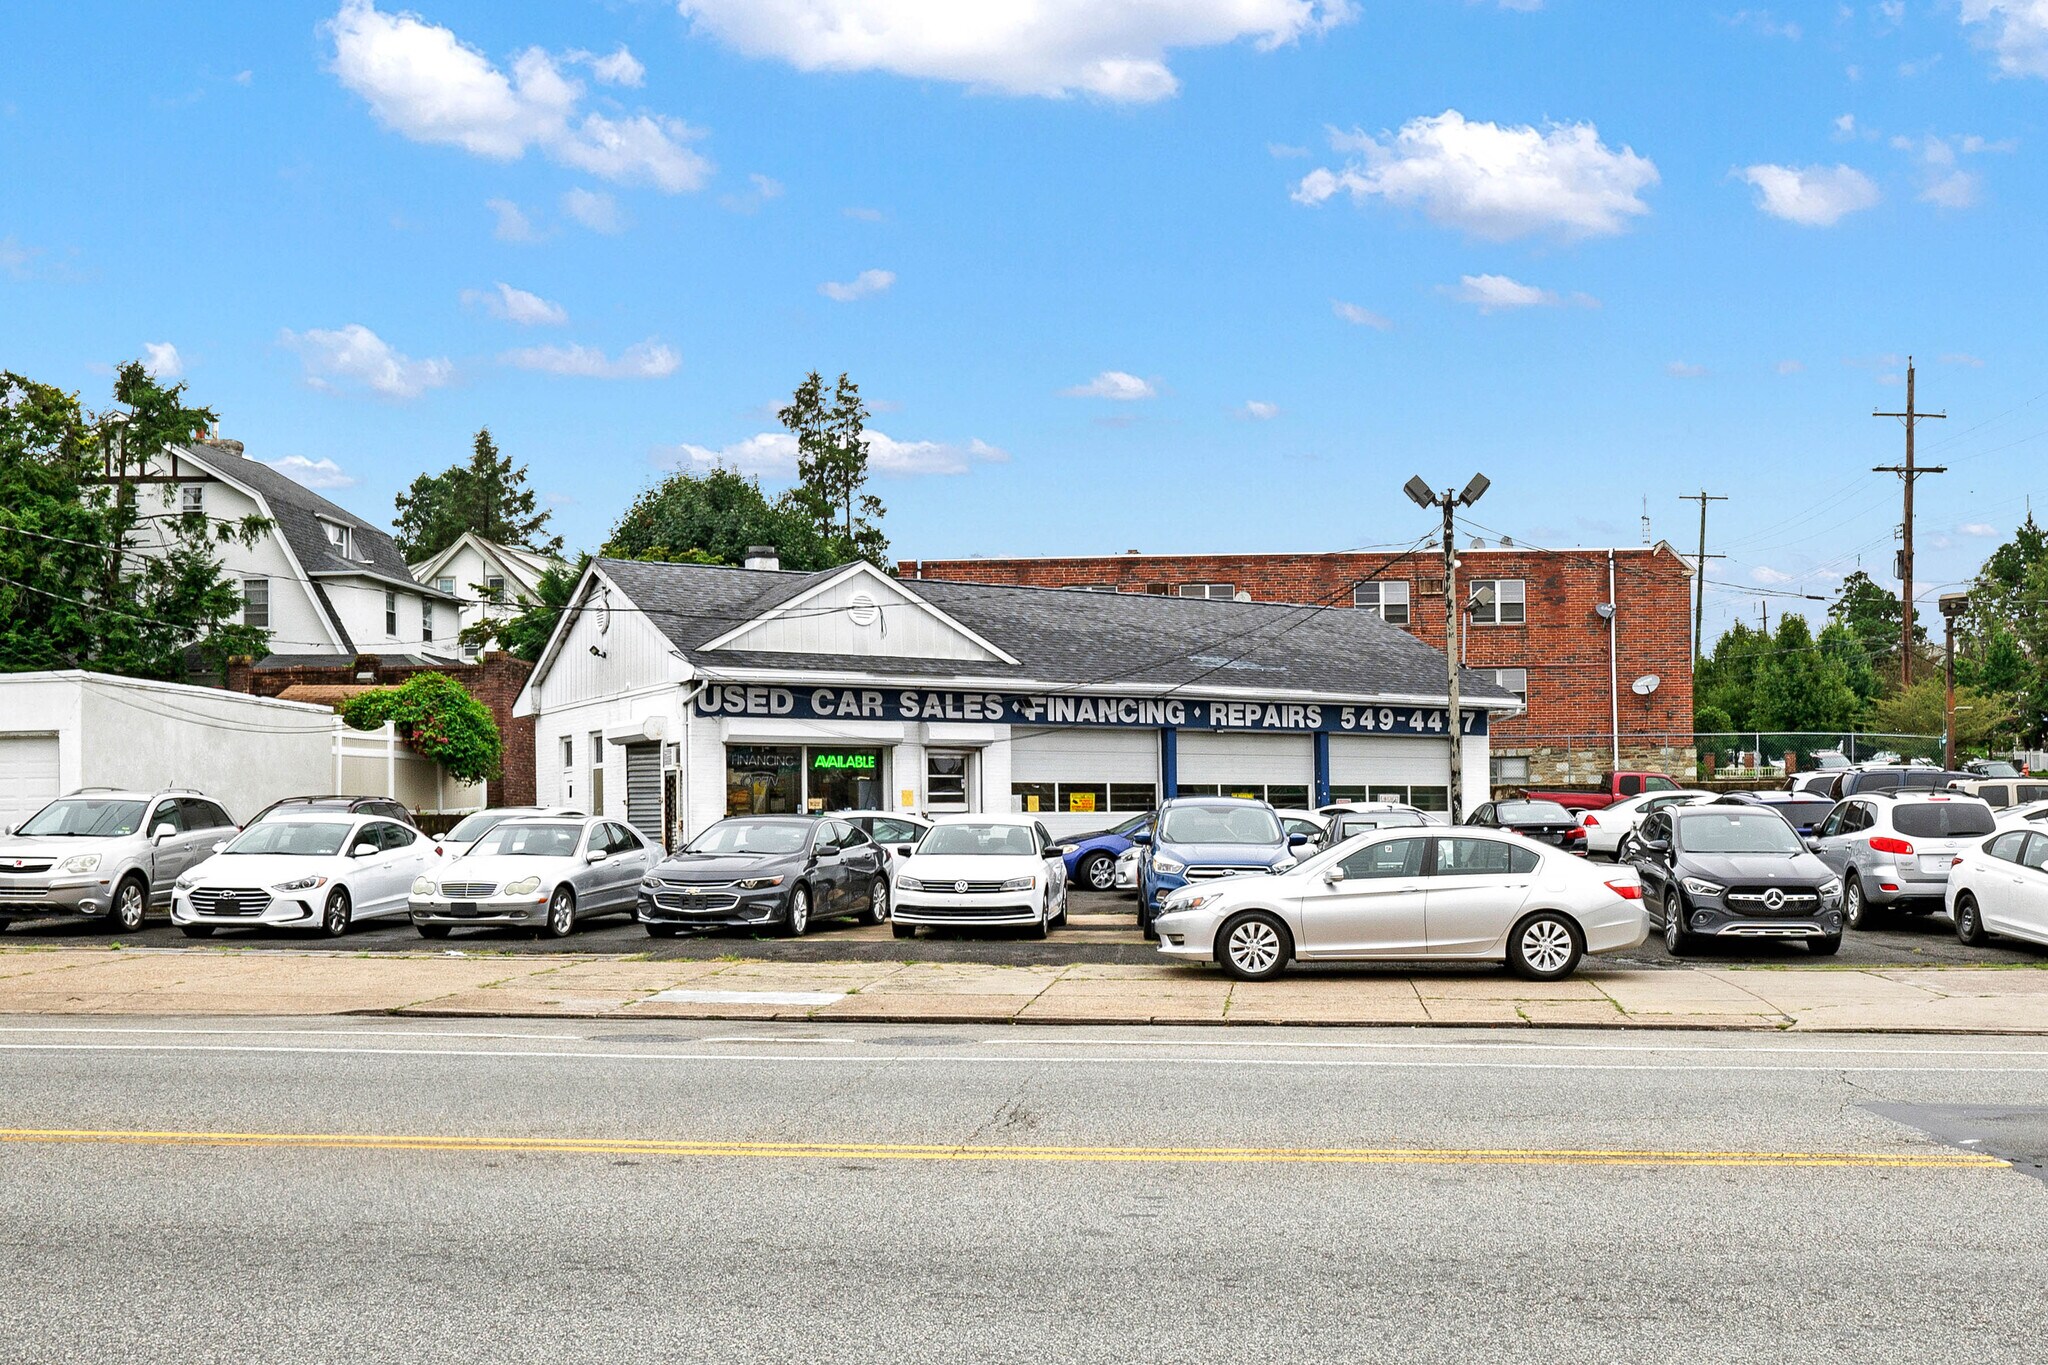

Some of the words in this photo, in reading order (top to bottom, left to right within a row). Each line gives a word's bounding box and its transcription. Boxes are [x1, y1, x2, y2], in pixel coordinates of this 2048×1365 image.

[697, 685, 794, 715] USED
[811, 688, 883, 717] CAR
[899, 691, 1004, 721] SALES
[1028, 697, 1186, 725] FINANCING
[1210, 702, 1323, 729] REPAIRS
[1340, 706, 1476, 734] 549-447
[814, 754, 876, 768] AVAILABLE
